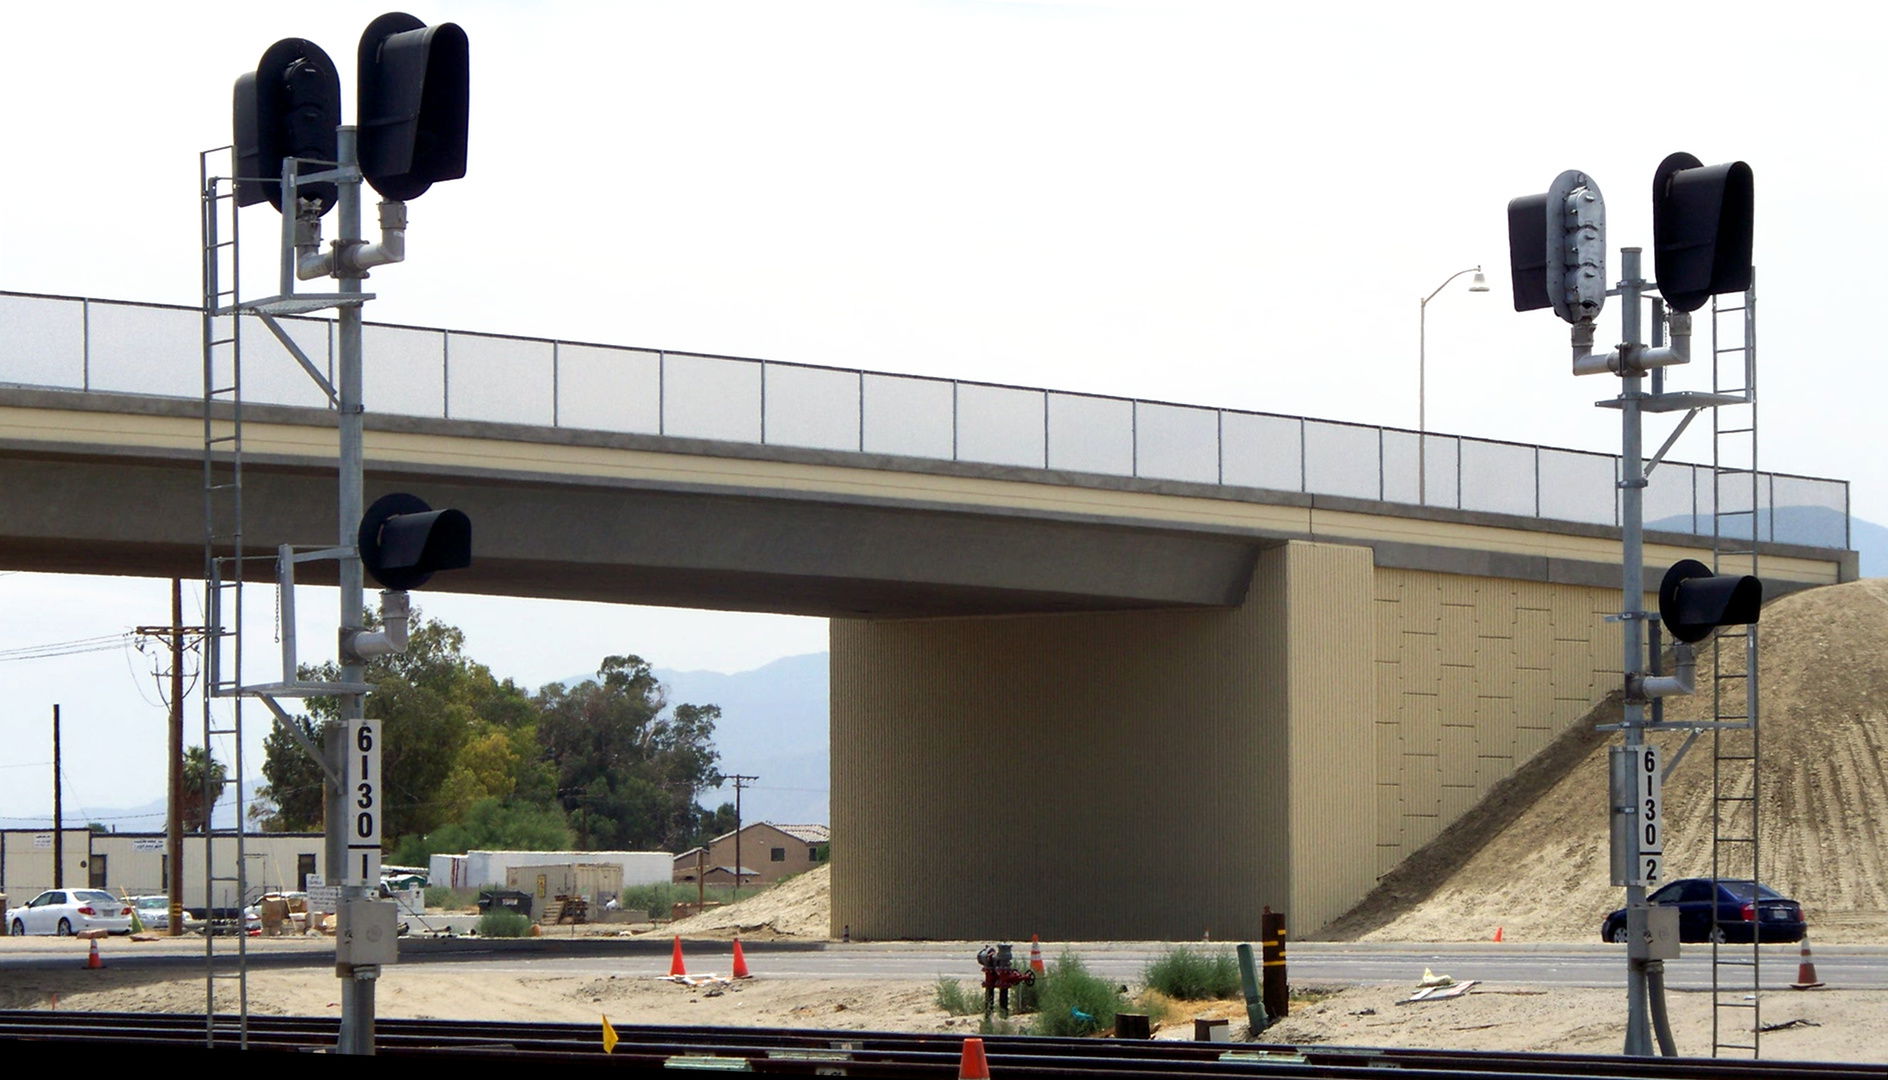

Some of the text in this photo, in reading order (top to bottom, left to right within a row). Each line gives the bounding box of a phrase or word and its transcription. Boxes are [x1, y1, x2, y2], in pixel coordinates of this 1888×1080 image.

[357, 726, 373, 838] 6130
[1644, 750, 1657, 881] 6130 2
